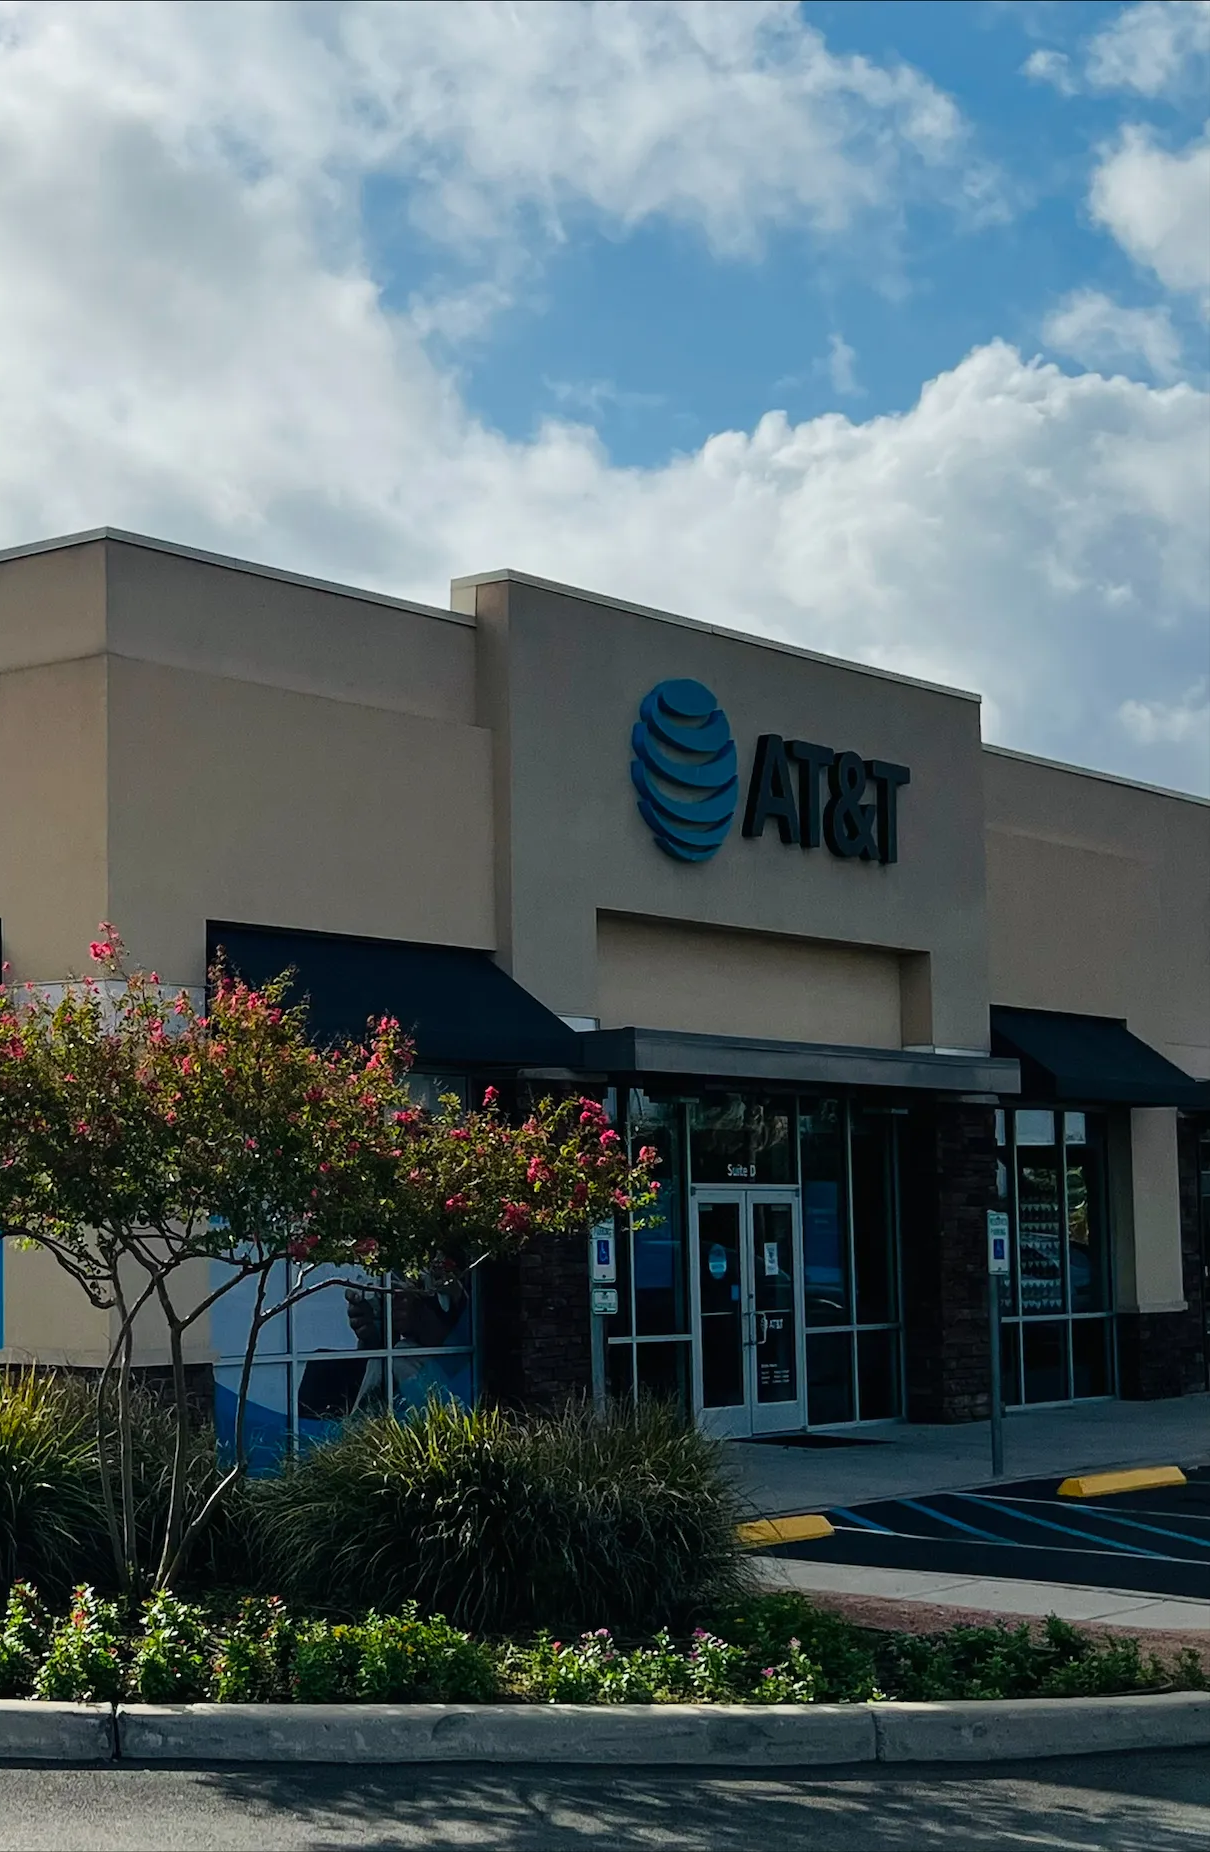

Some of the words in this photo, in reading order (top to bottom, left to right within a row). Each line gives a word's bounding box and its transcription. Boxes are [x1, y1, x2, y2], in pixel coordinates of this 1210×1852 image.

[742, 734, 911, 864] AT&T
[727, 1163, 748, 1178] Suite
[750, 1164, 757, 1178] D
